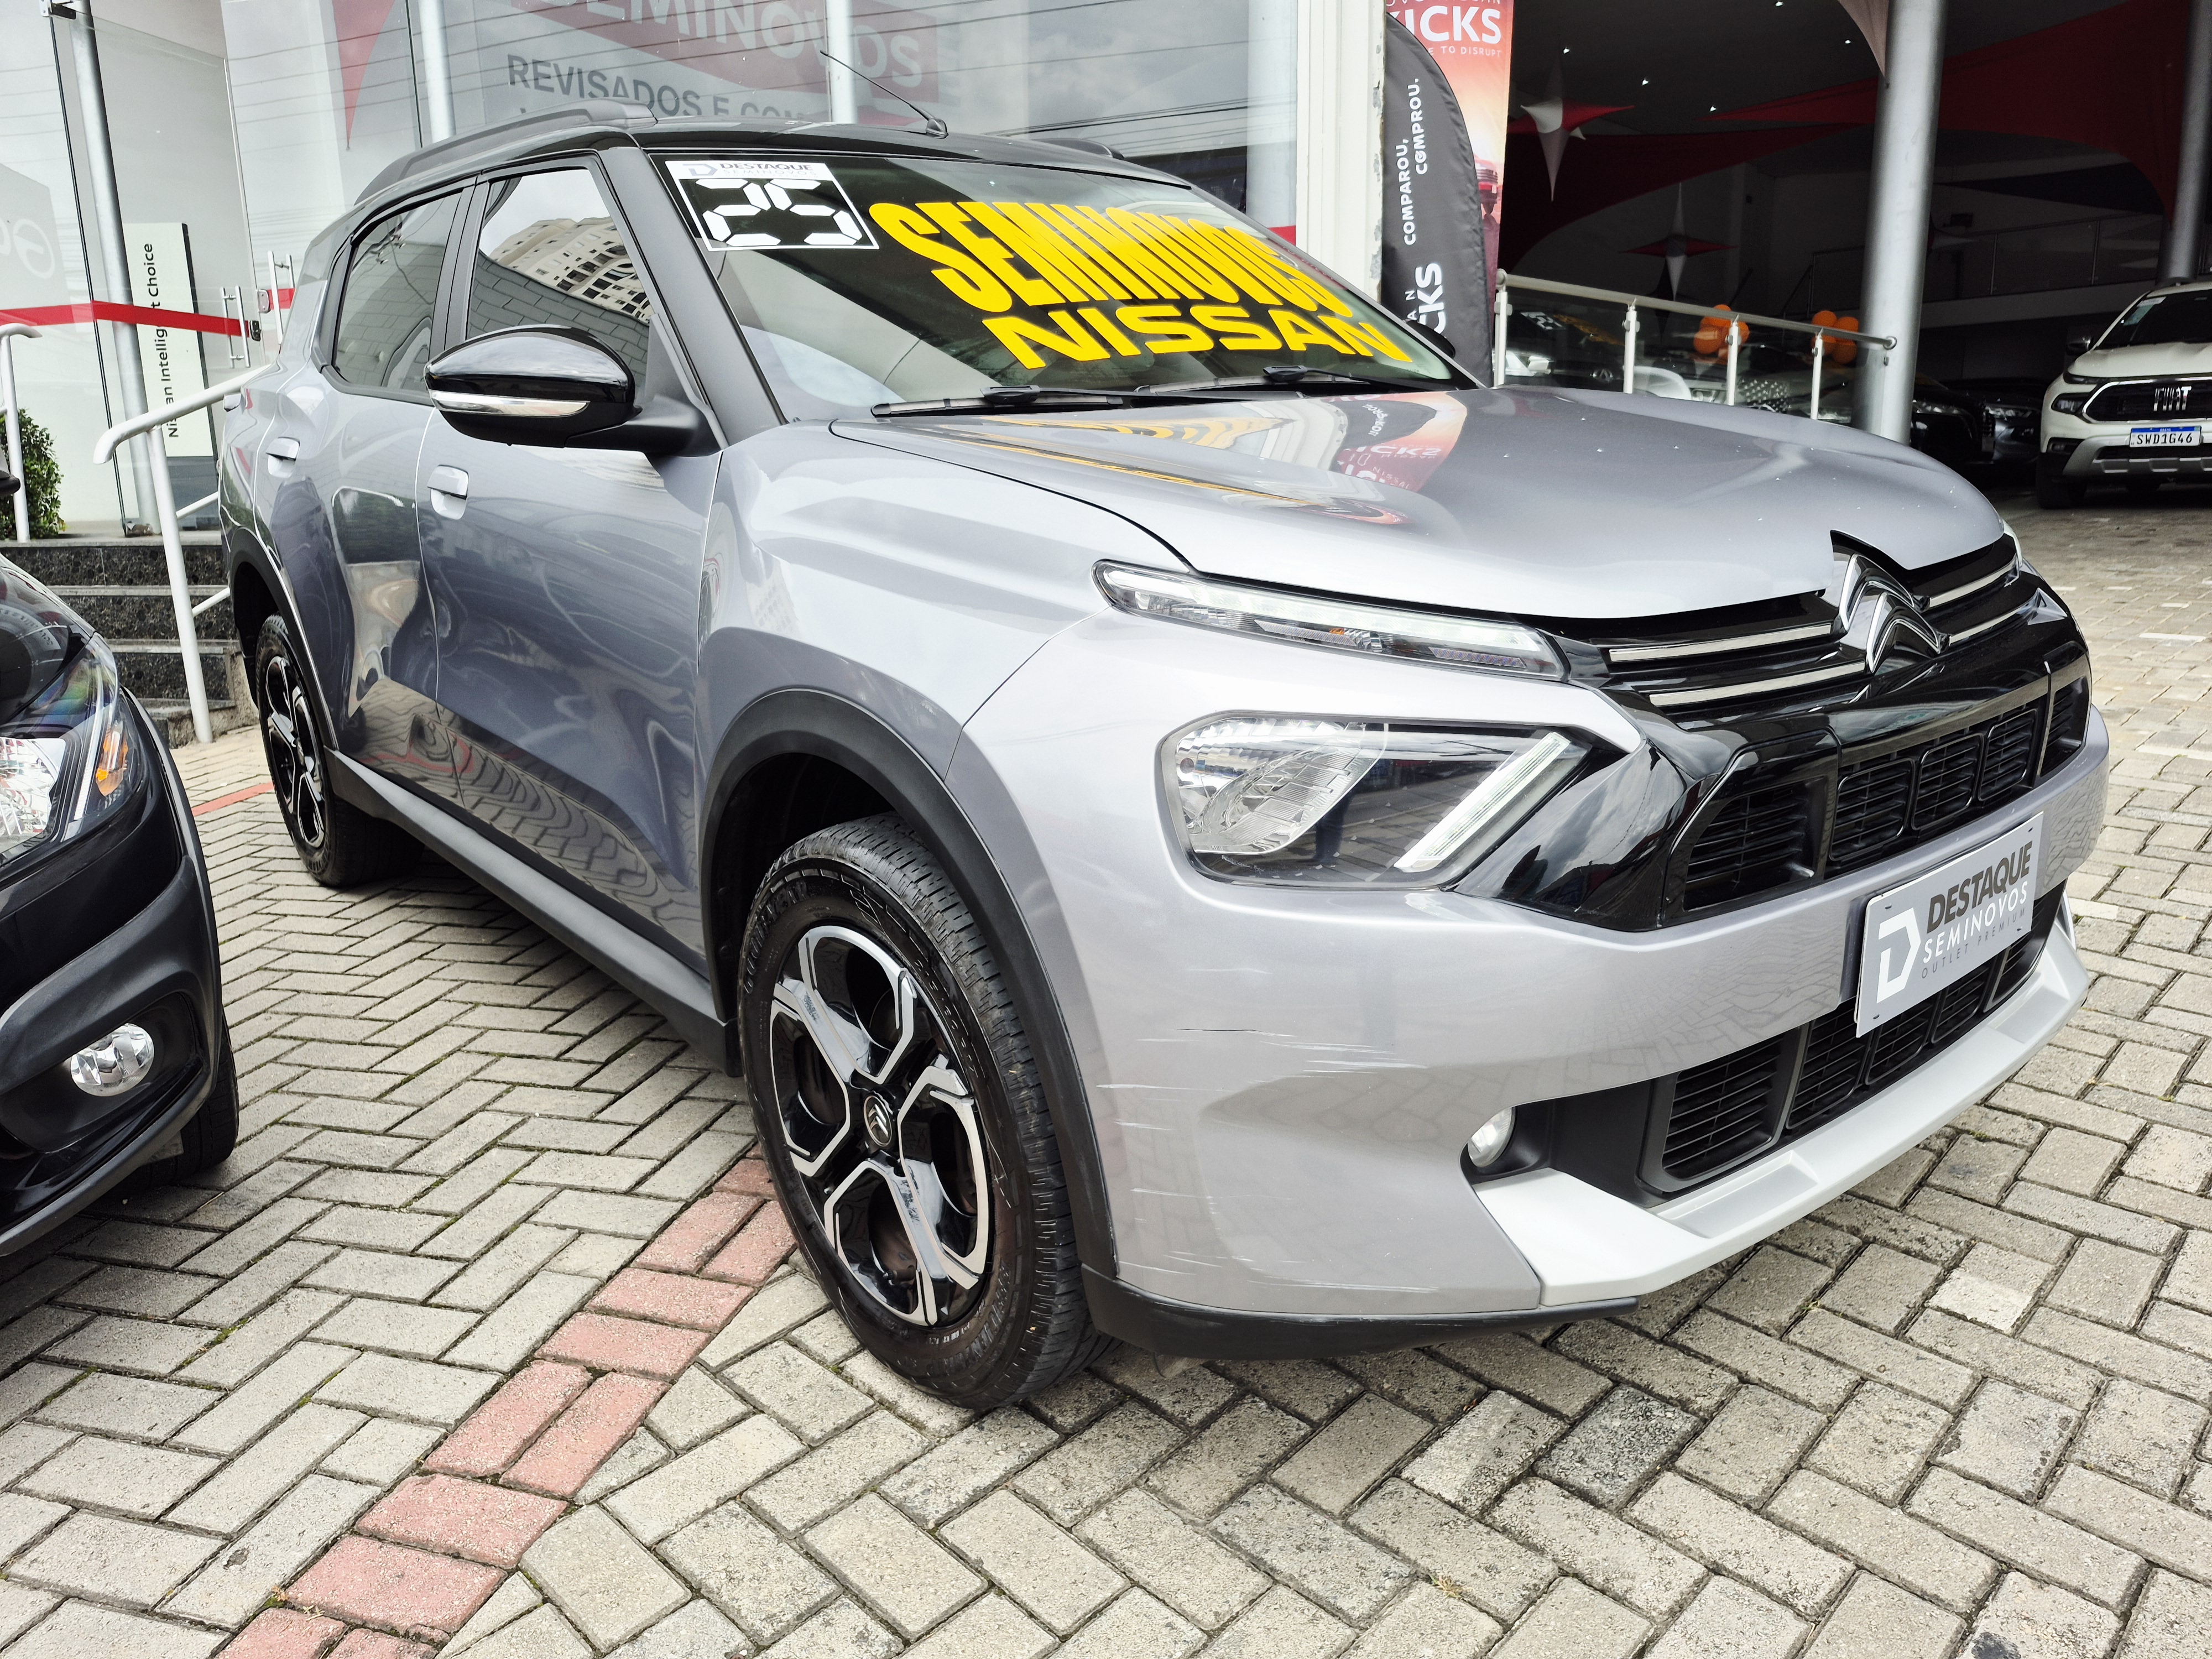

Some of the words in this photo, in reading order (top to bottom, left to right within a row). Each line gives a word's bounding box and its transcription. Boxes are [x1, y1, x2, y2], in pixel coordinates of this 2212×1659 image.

[1387, 6, 1501, 44] ICKS
[1441, 46, 1455, 54] TO
[1460, 46, 1501, 57] DISRUPT
[695, 179, 863, 247] 25
[1395, 139, 1417, 246] COMPAROU,
[144, 243, 159, 297] Choice
[870, 202, 1353, 319] SEMINOVOS
[1415, 263, 1446, 334] CKS
[150, 301, 170, 381] Intelligt
[982, 306, 1412, 369] NISSAN
[165, 387, 179, 437] Nian
[2153, 386, 2192, 411] FIAT
[2136, 433, 2193, 445] SWD1G46
[1923, 880, 2028, 963] SEMINOVOS
[1926, 841, 2032, 934] DESTAQUE
[1921, 943, 1969, 979] OUTLET
[1978, 907, 2025, 946] PREMIUM
